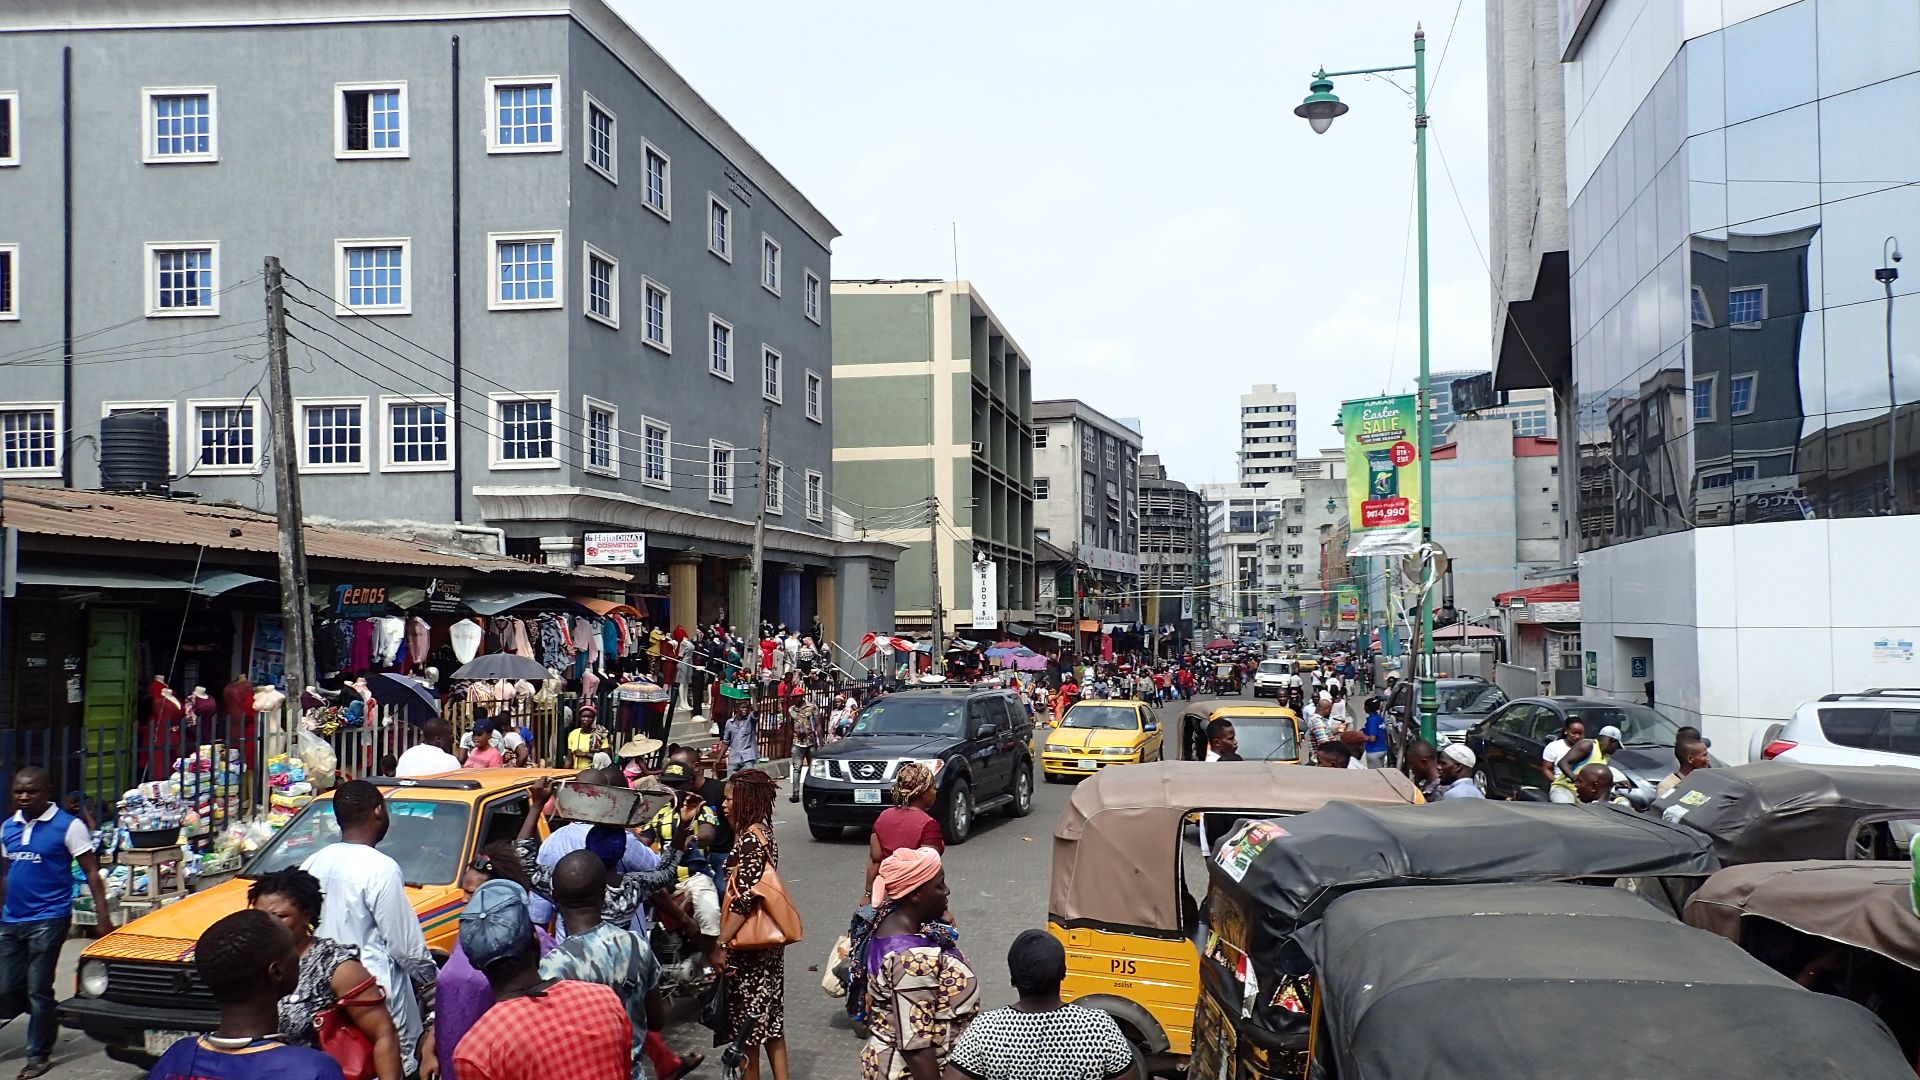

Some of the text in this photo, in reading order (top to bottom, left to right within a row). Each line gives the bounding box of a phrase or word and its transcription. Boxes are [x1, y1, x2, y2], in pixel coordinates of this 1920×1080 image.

[1363, 406, 1400, 420] Easter
[1363, 416, 1399, 434] SALE
[1111, 959, 1136, 974] PJS
